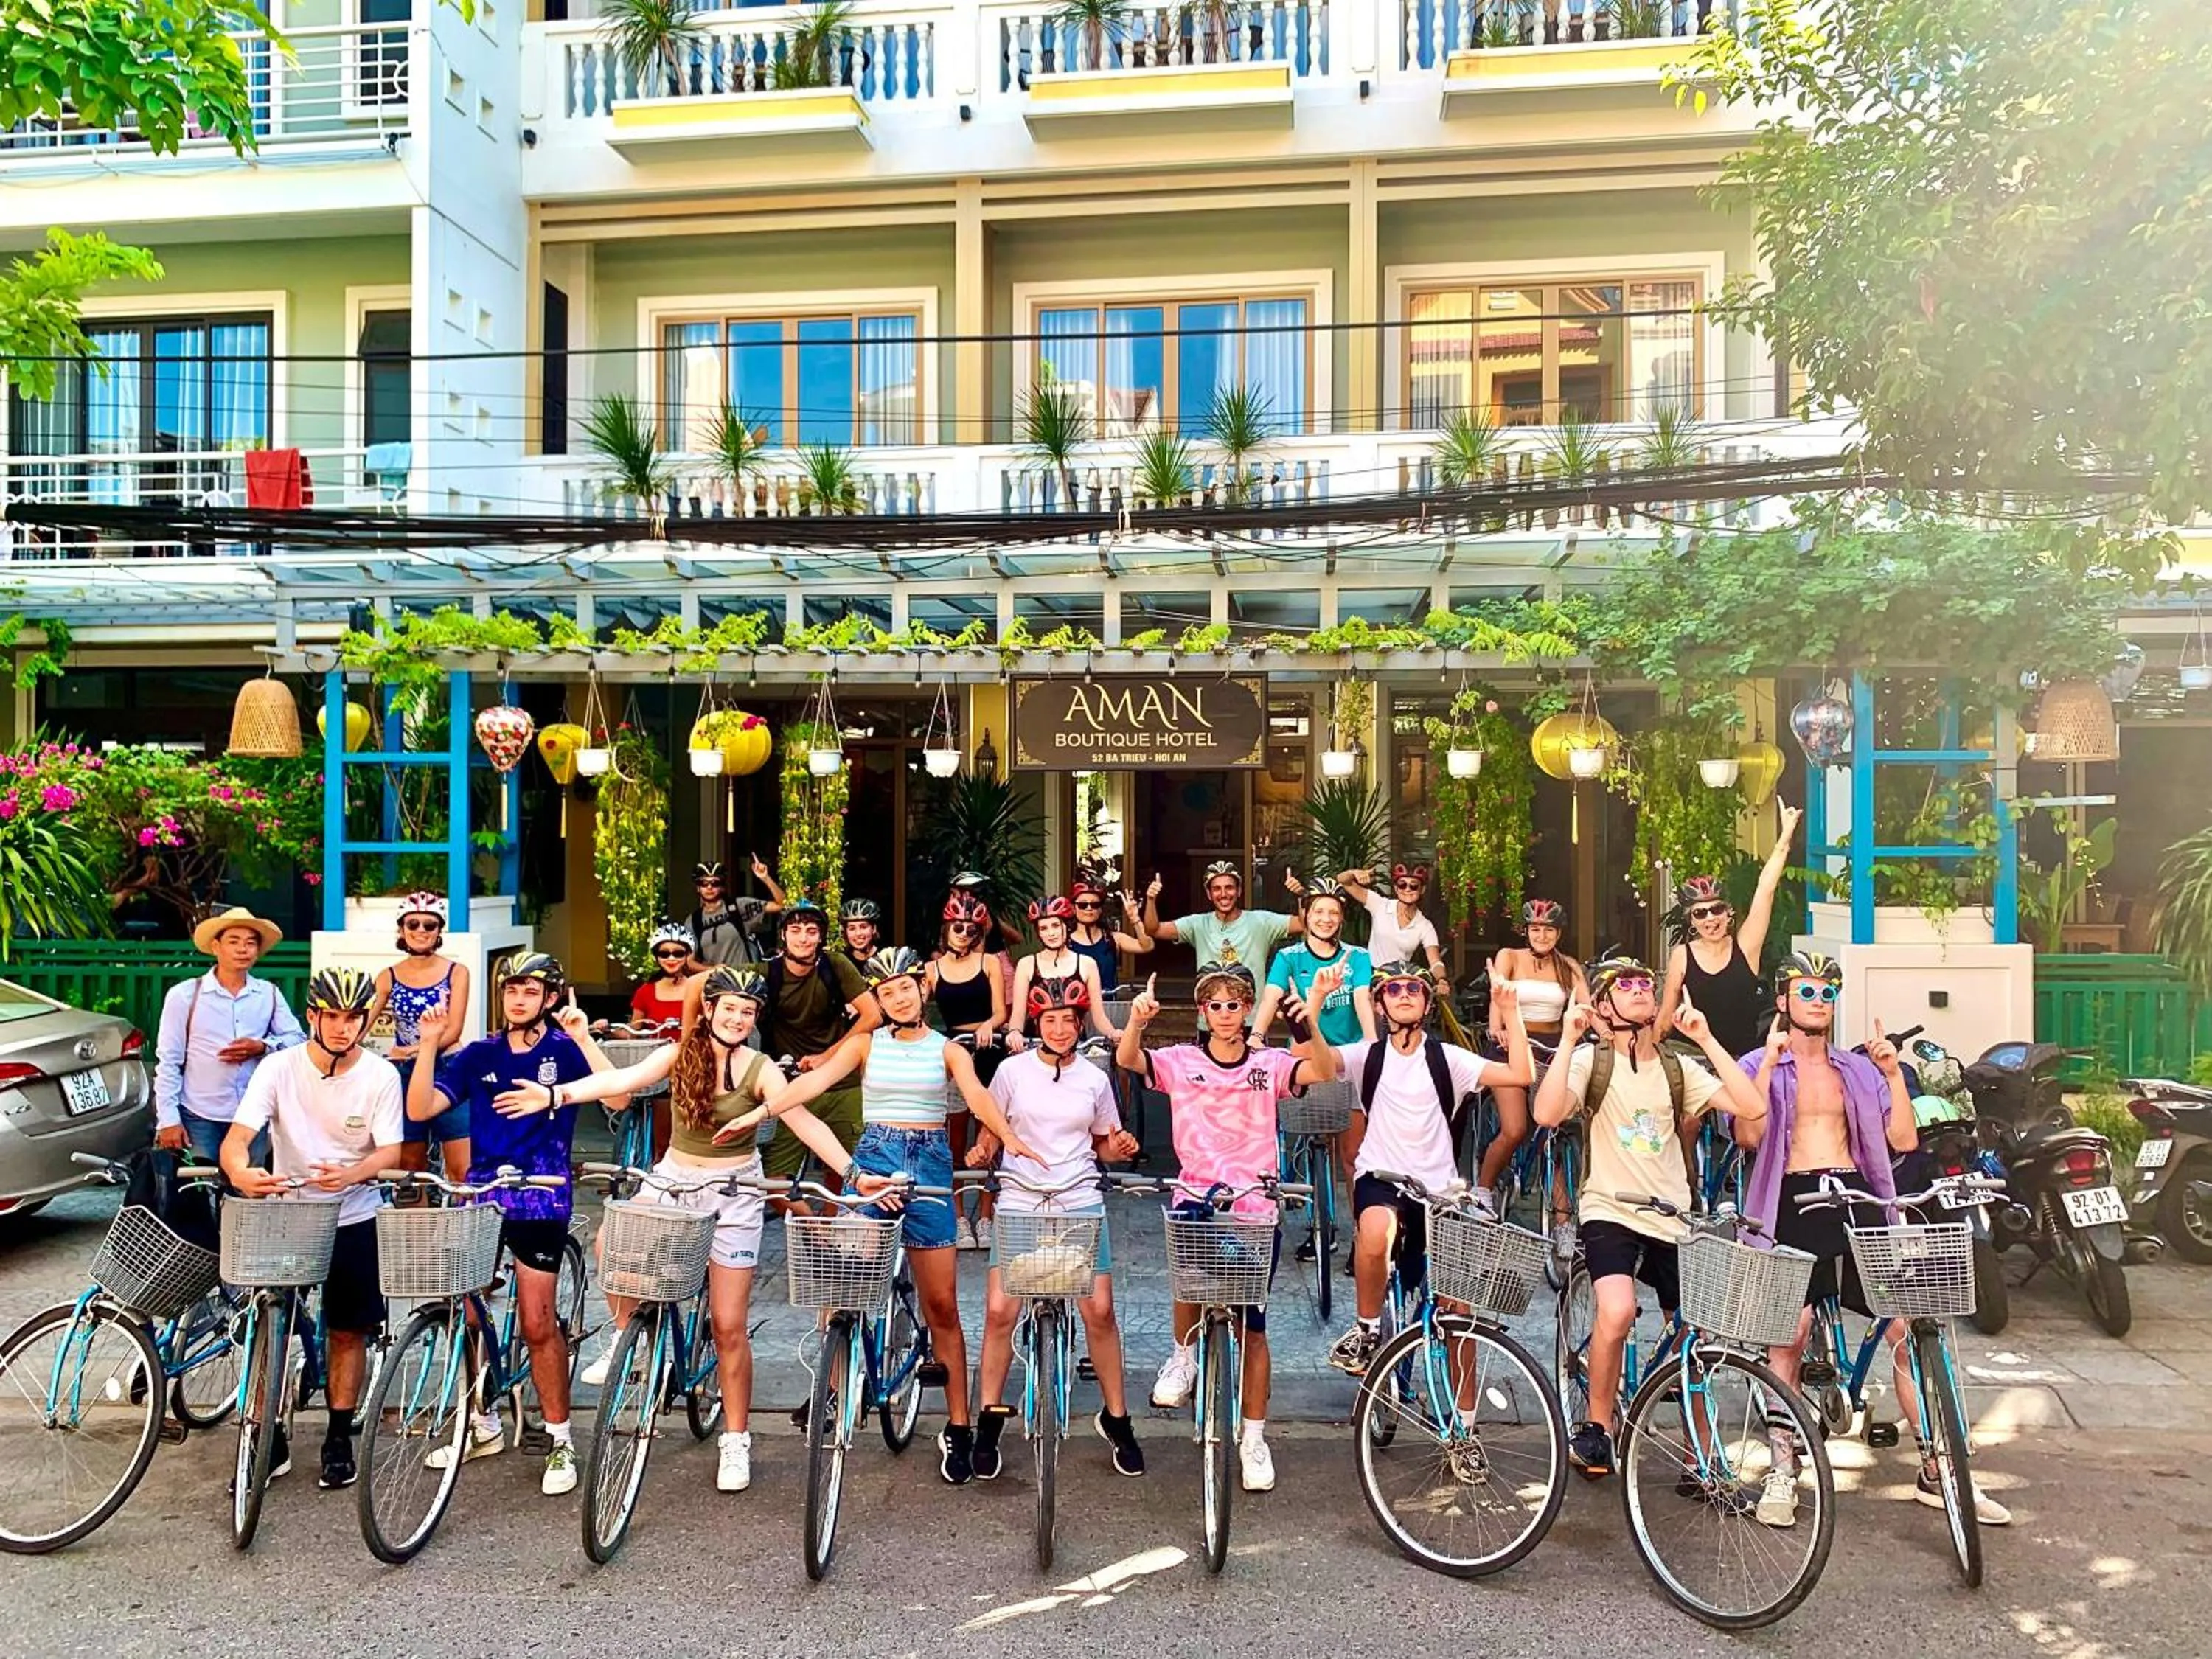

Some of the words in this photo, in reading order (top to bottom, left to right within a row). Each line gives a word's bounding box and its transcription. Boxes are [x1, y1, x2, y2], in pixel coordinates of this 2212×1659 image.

[1063, 682, 1213, 730] AMAN
[1055, 732, 1151, 747] BOUTIQUE
[1156, 732, 1217, 747] HOTEL
[1091, 753, 1104, 762] 52
[1105, 753, 1119, 762] BA
[1120, 753, 1147, 762] TRIEU
[1155, 753, 1170, 762] HOI
[1172, 753, 1186, 762] AN
